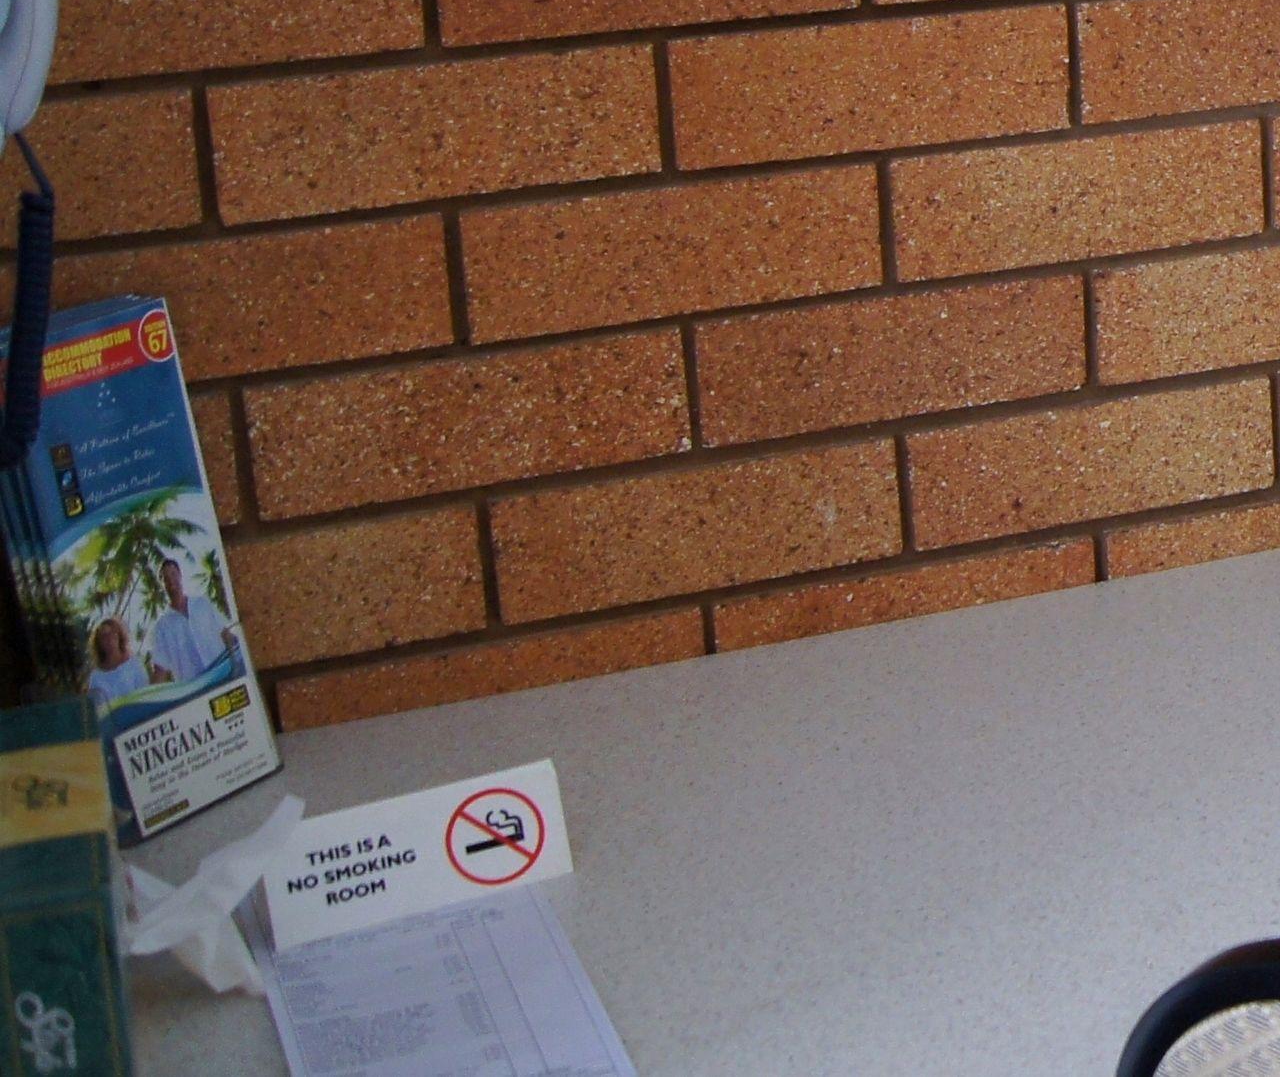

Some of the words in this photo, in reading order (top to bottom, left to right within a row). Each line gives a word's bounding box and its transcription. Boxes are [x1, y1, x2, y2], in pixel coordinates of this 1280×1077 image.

[148, 329, 168, 354] 67
[124, 719, 179, 753] MOTEL
[130, 718, 216, 780] NINGANA
[305, 843, 352, 866] THIS
[356, 837, 374, 854] IS
[378, 833, 392, 849] A
[287, 874, 319, 894] NO
[324, 848, 417, 884] SMOKING
[326, 878, 387, 906] ROOM
